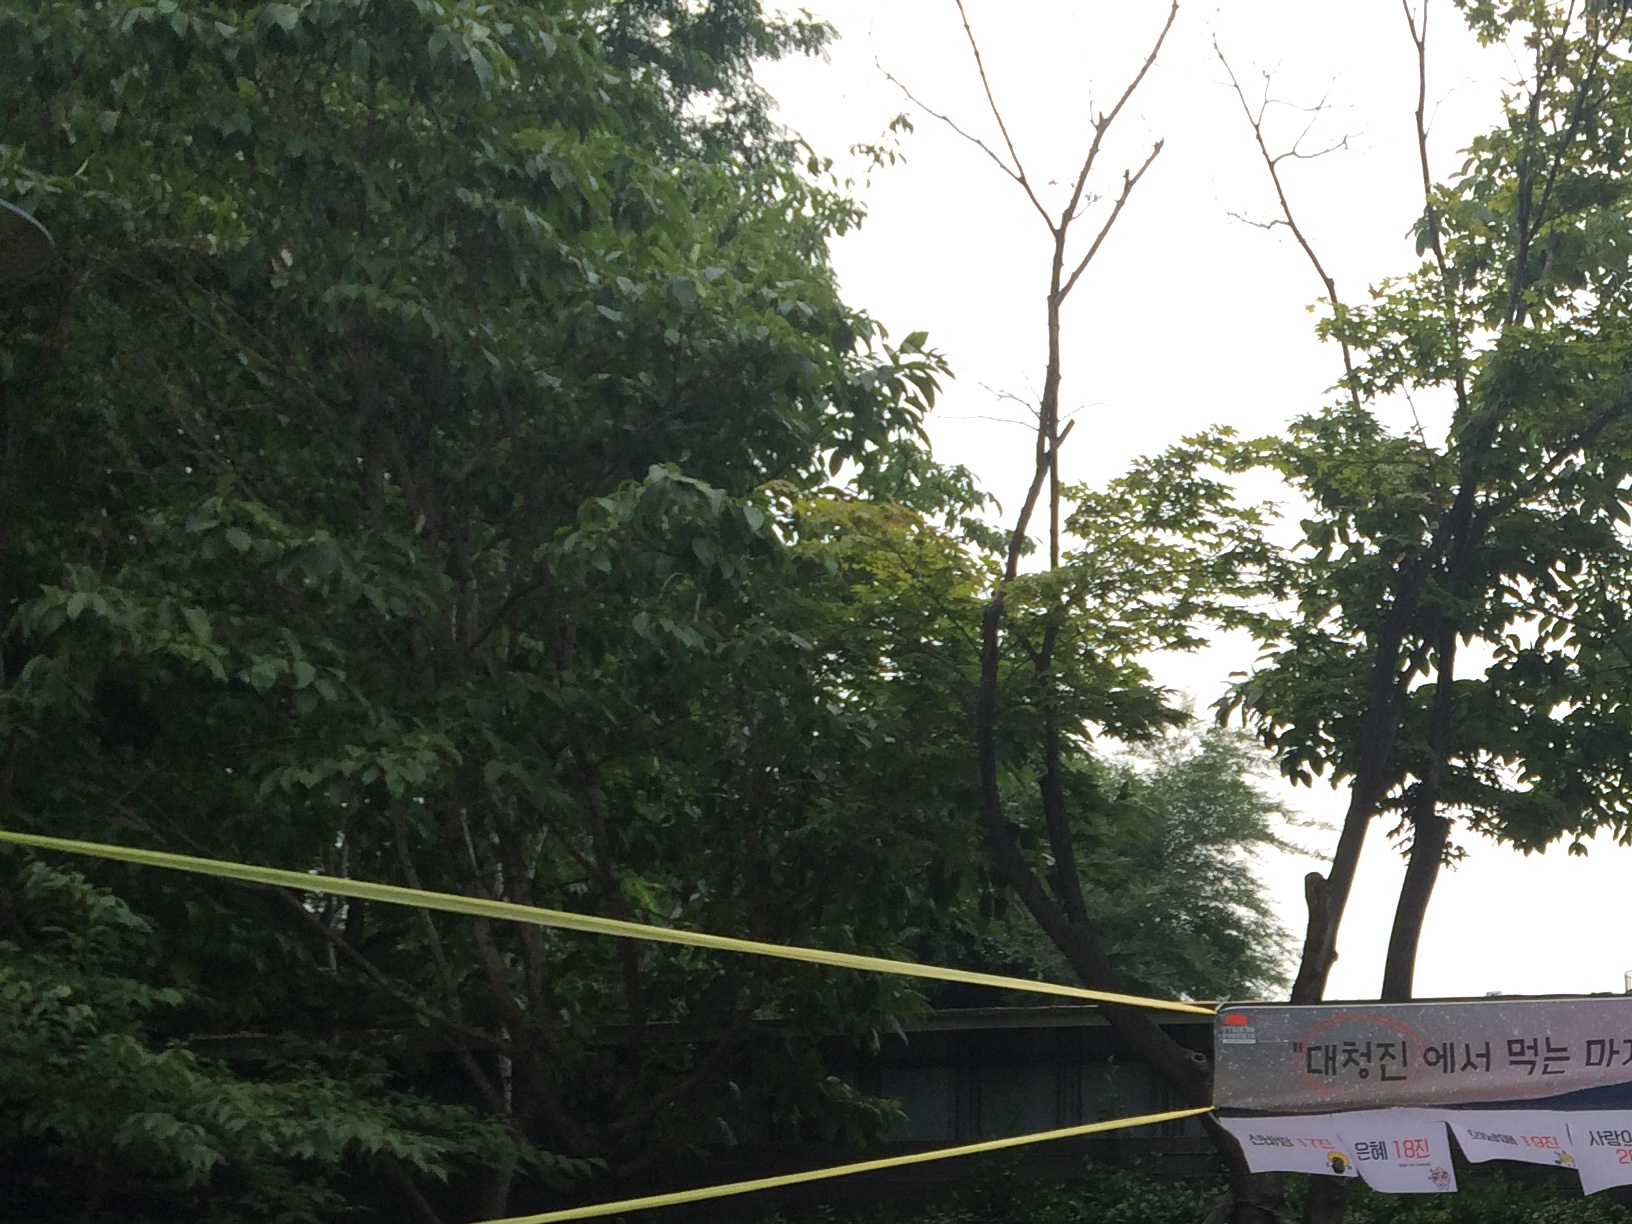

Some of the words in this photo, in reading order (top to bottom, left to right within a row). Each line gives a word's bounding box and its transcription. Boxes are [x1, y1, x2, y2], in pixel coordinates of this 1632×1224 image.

[1423, 1042, 1491, 1073] 에서
[1506, 1037, 1571, 1075] 먹는
[1355, 1141, 1388, 1160] 은혜
[1393, 1138, 1431, 1159] 18진
[1521, 1135, 1561, 1148] 19진
